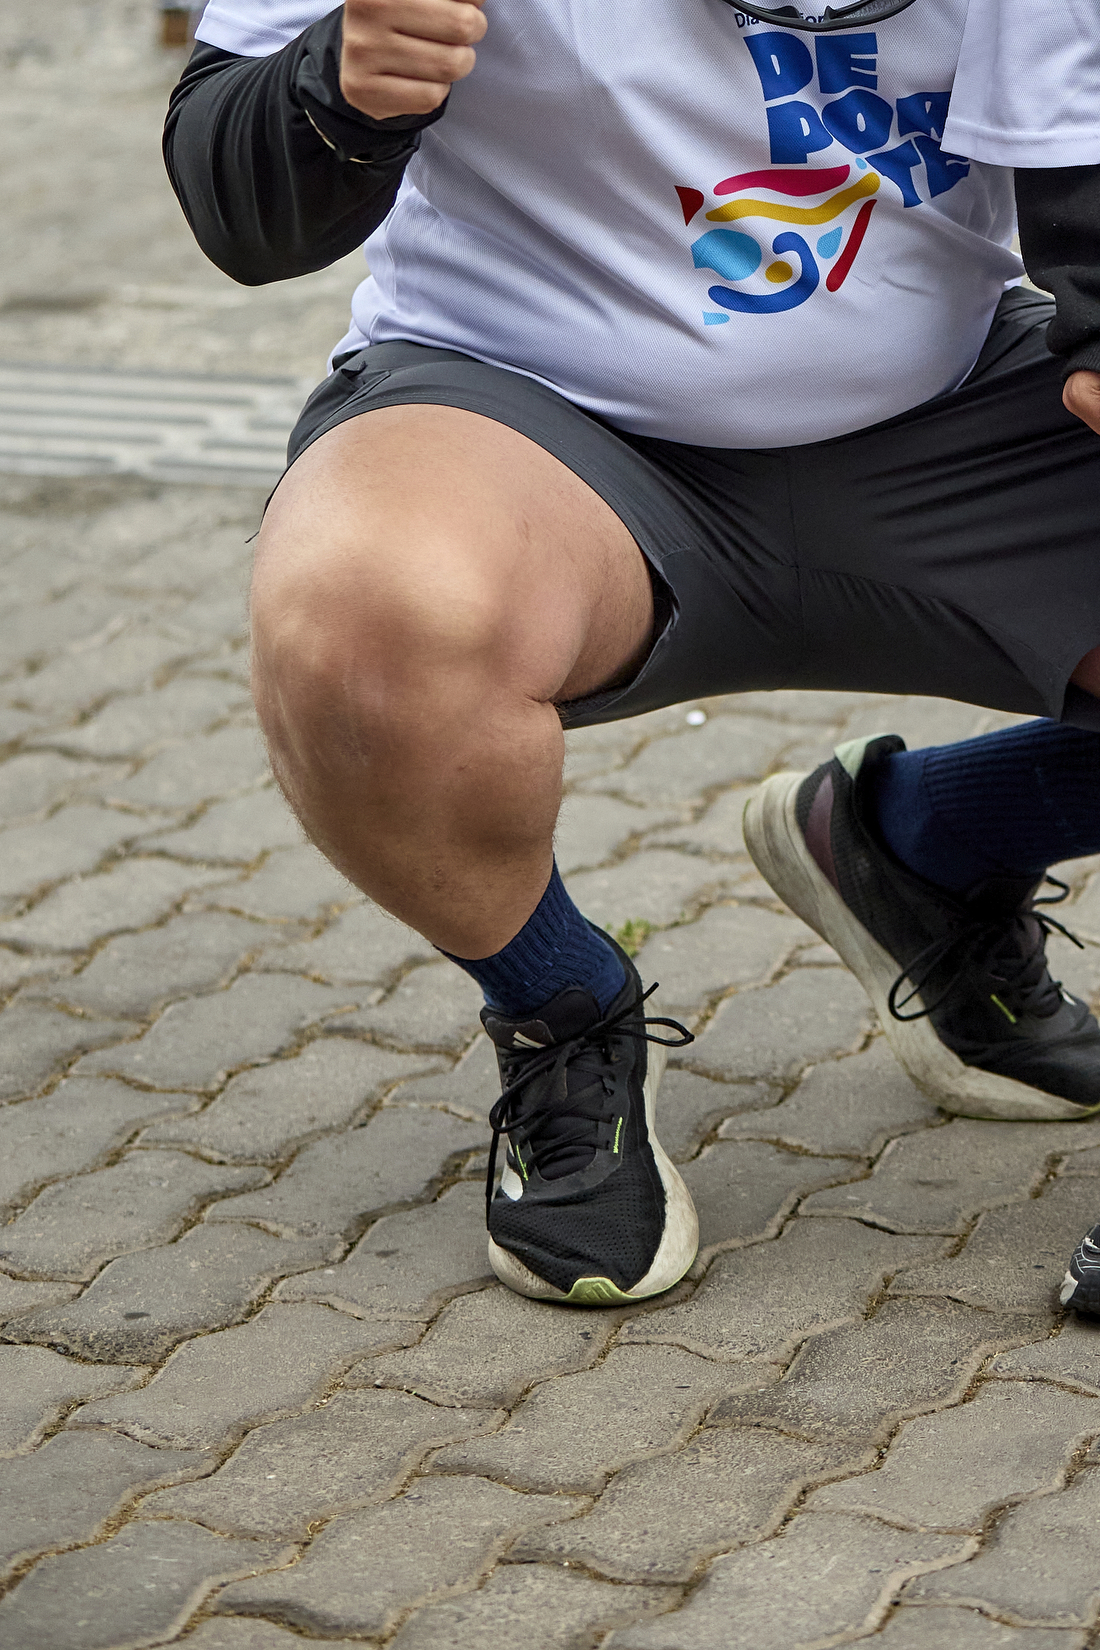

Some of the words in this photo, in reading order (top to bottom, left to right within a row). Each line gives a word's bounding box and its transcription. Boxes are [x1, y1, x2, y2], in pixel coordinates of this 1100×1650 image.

[743, 31, 878, 101] DE
[766, 89, 951, 164] POR
[865, 135, 970, 208] TE
